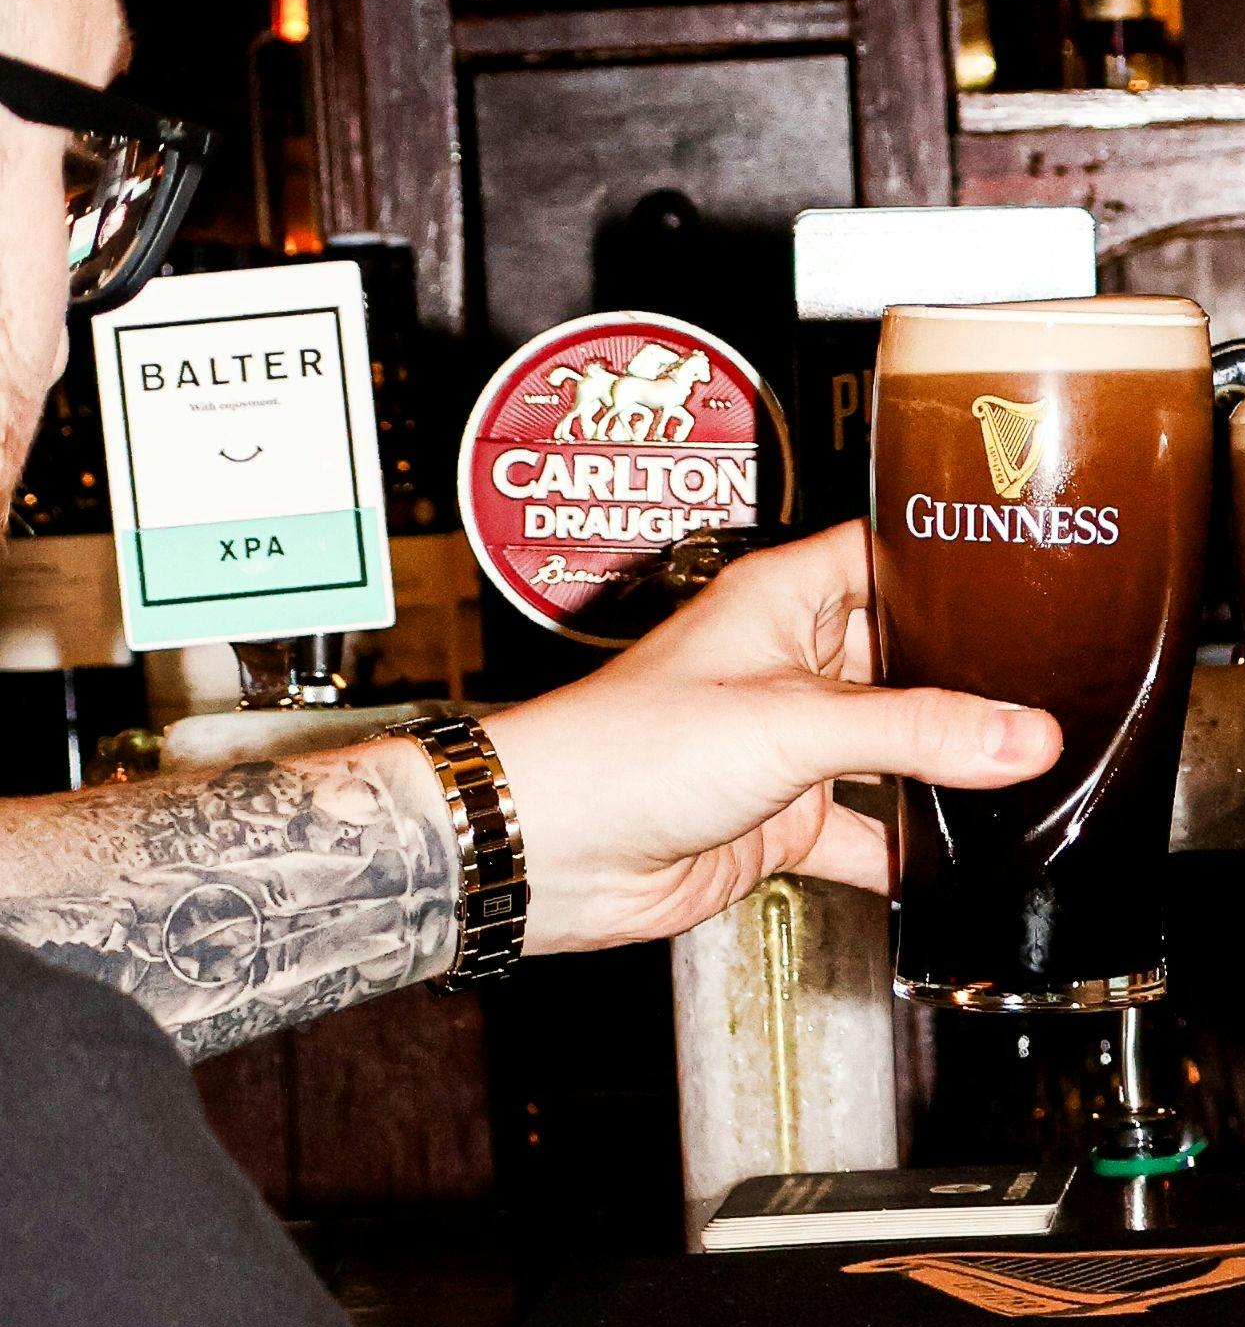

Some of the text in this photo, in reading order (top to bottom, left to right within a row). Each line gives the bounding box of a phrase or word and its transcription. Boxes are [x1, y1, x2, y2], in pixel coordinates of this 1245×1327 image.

[141, 348, 323, 392] BALTER
[492, 448, 758, 505] CARLTON
[905, 493, 1120, 546] GUINNESS
[219, 534, 285, 562] XPA
